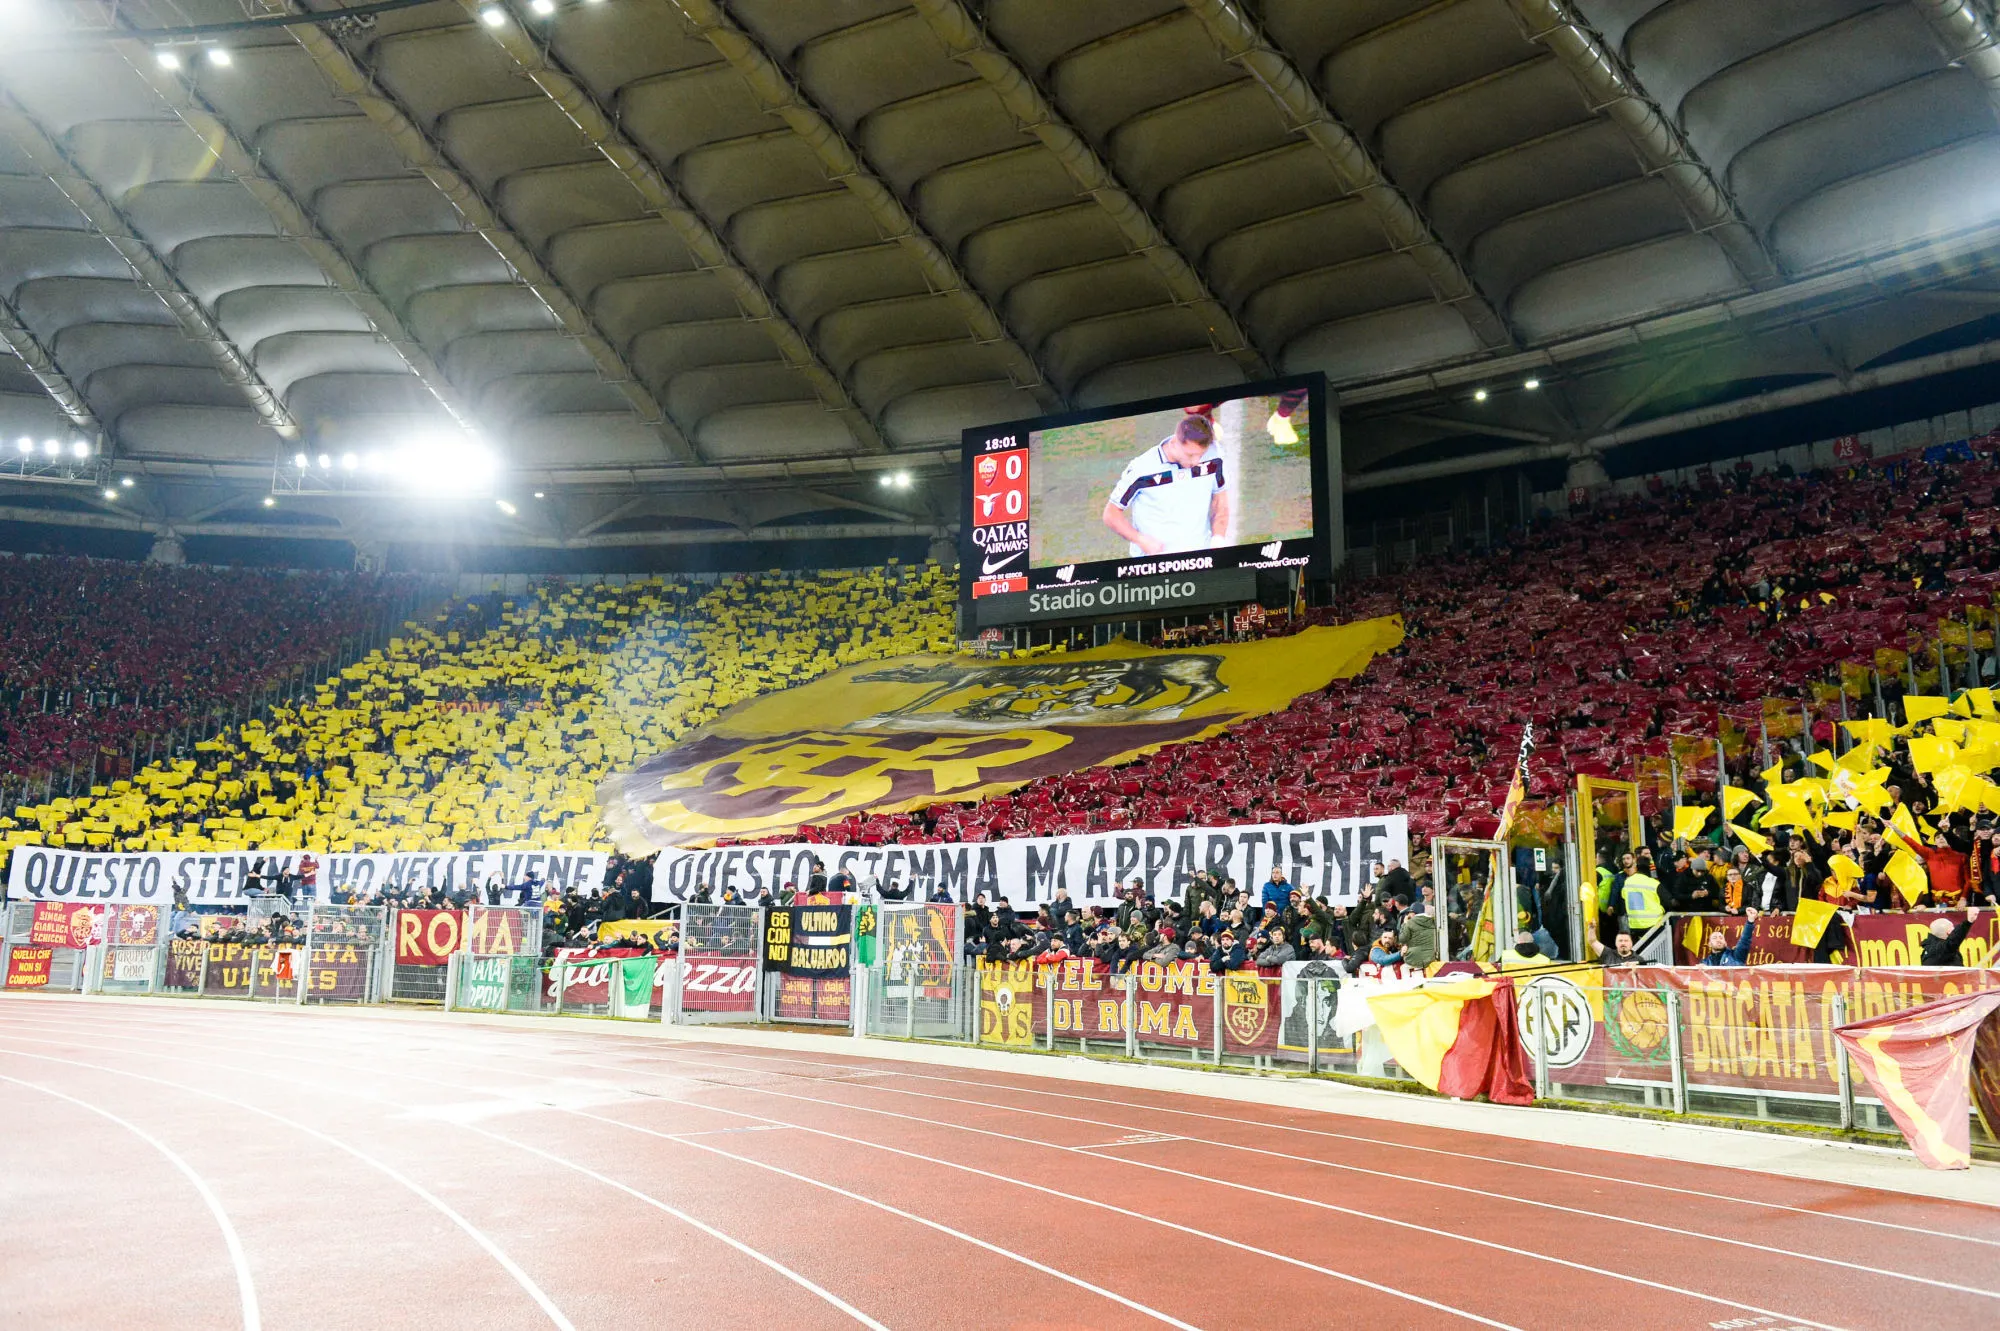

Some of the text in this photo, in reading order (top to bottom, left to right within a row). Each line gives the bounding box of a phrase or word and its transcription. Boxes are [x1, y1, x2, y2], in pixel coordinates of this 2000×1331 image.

[985, 436, 1017, 450] 18:01
[1840, 437, 1852, 447] 18
[1005, 455, 1022, 480] 0
[1005, 490, 1022, 515] 0
[972, 522, 1028, 547] QATAR
[985, 539, 1029, 555] AIRWAYS
[1117, 557, 1213, 577] MATCH SPONSOR
[991, 582, 1009, 594] 0:0
[1029, 588, 1095, 612] Stadio
[1100, 579, 1196, 606] Olimpico
[1247, 603, 1258, 615] 19
[986, 627, 998, 638] 20
[669, 825, 1388, 902] QUESTO STEMMA MI APPARTIENE
[25, 851, 159, 898] QUESTO
[329, 859, 375, 898] HO
[771, 911, 790, 928] 66
[801, 911, 838, 932] ULTIMO
[400, 911, 514, 956] ROMA
[767, 928, 791, 944] CON
[12, 949, 36, 960] QUELLI
[117, 949, 152, 964] GRUPPO
[768, 945, 788, 960] NOI
[790, 947, 847, 969] BALUARDO
[18, 962, 42, 972] NON SI
[174, 955, 202, 971] VIVE
[8, 974, 47, 985] COMPRANO
[1035, 958, 1102, 991] NEL
[1054, 999, 1199, 1040] DI ROMA
[1688, 979, 1817, 1079] BRIGATA
